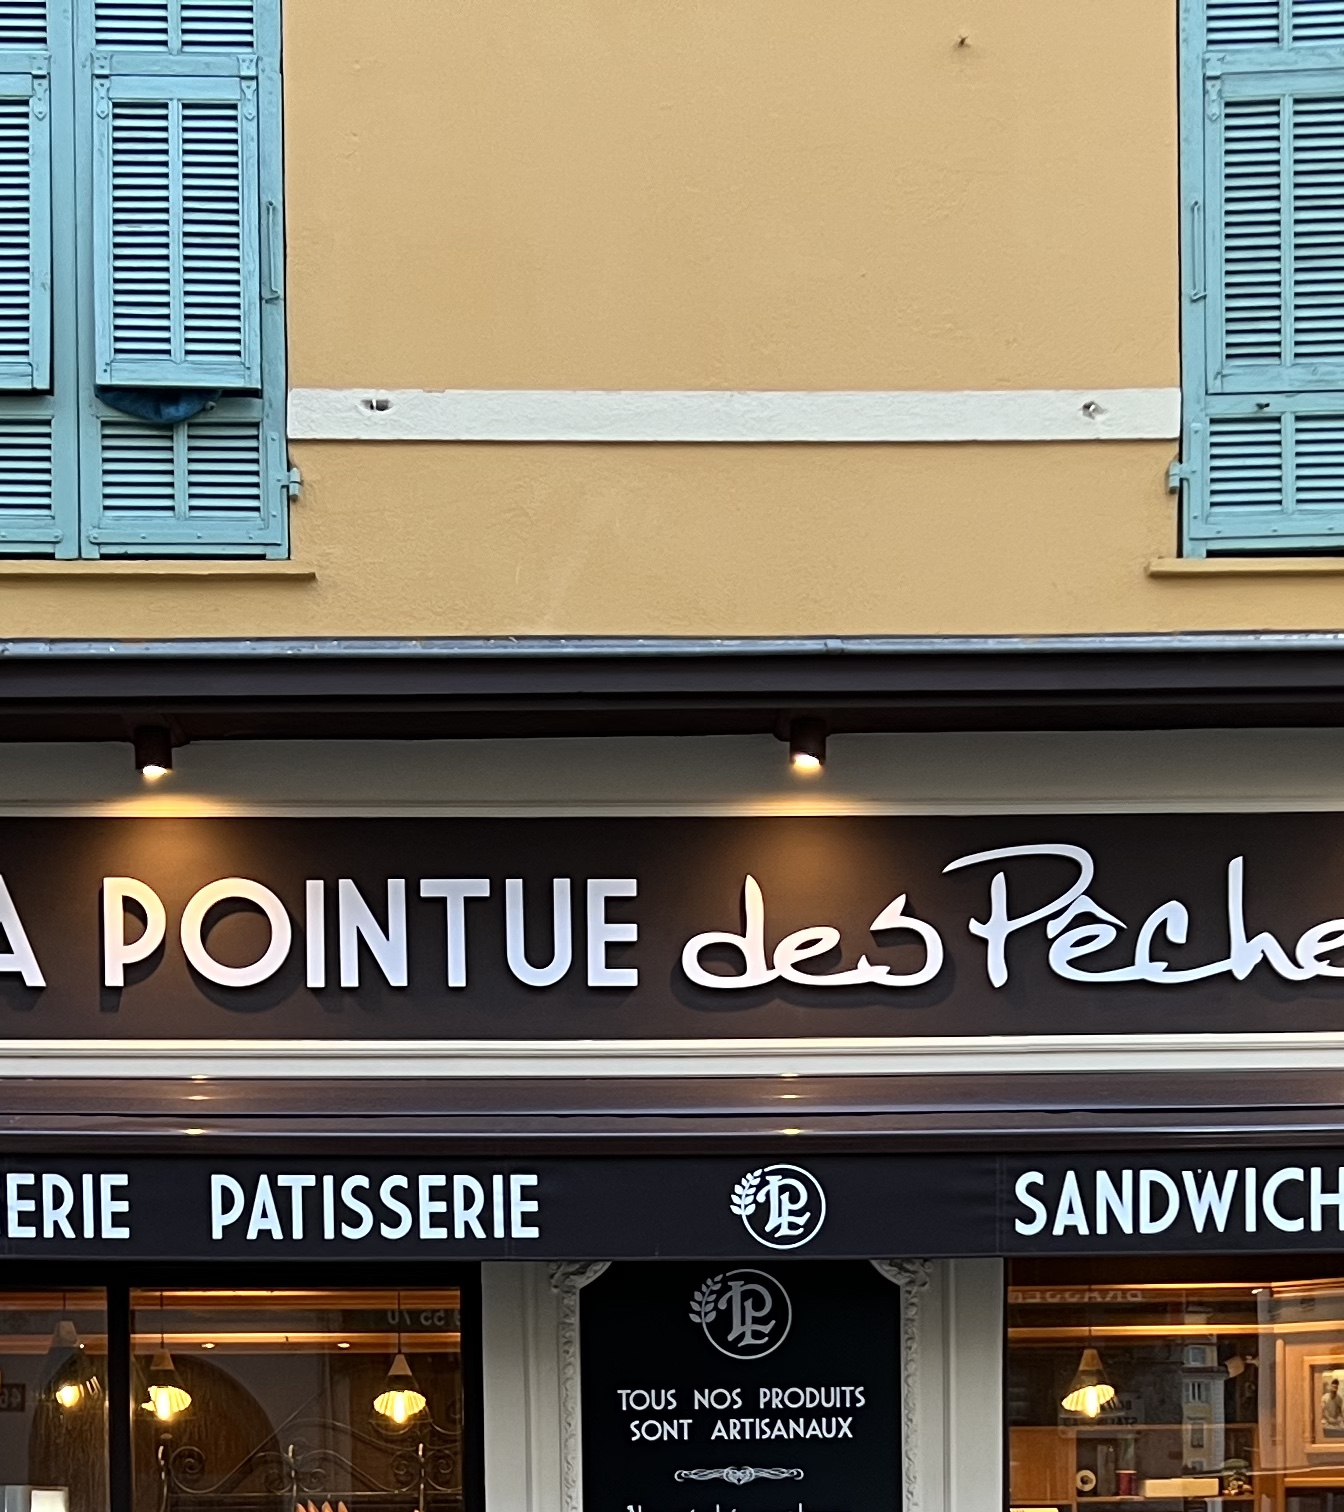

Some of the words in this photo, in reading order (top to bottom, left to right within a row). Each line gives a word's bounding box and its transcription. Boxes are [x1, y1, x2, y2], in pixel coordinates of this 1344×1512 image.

[103, 875, 640, 989] POINTUE
[681, 873, 944, 991] des
[210, 1173, 540, 1240] PATISSERIE
[617, 1388, 678, 1412] TOUS
[693, 1388, 743, 1411] NOS
[758, 1386, 866, 1410] PRODUITS
[629, 1418, 693, 1442] SONT
[710, 1416, 854, 1441] ARTISANAUX
